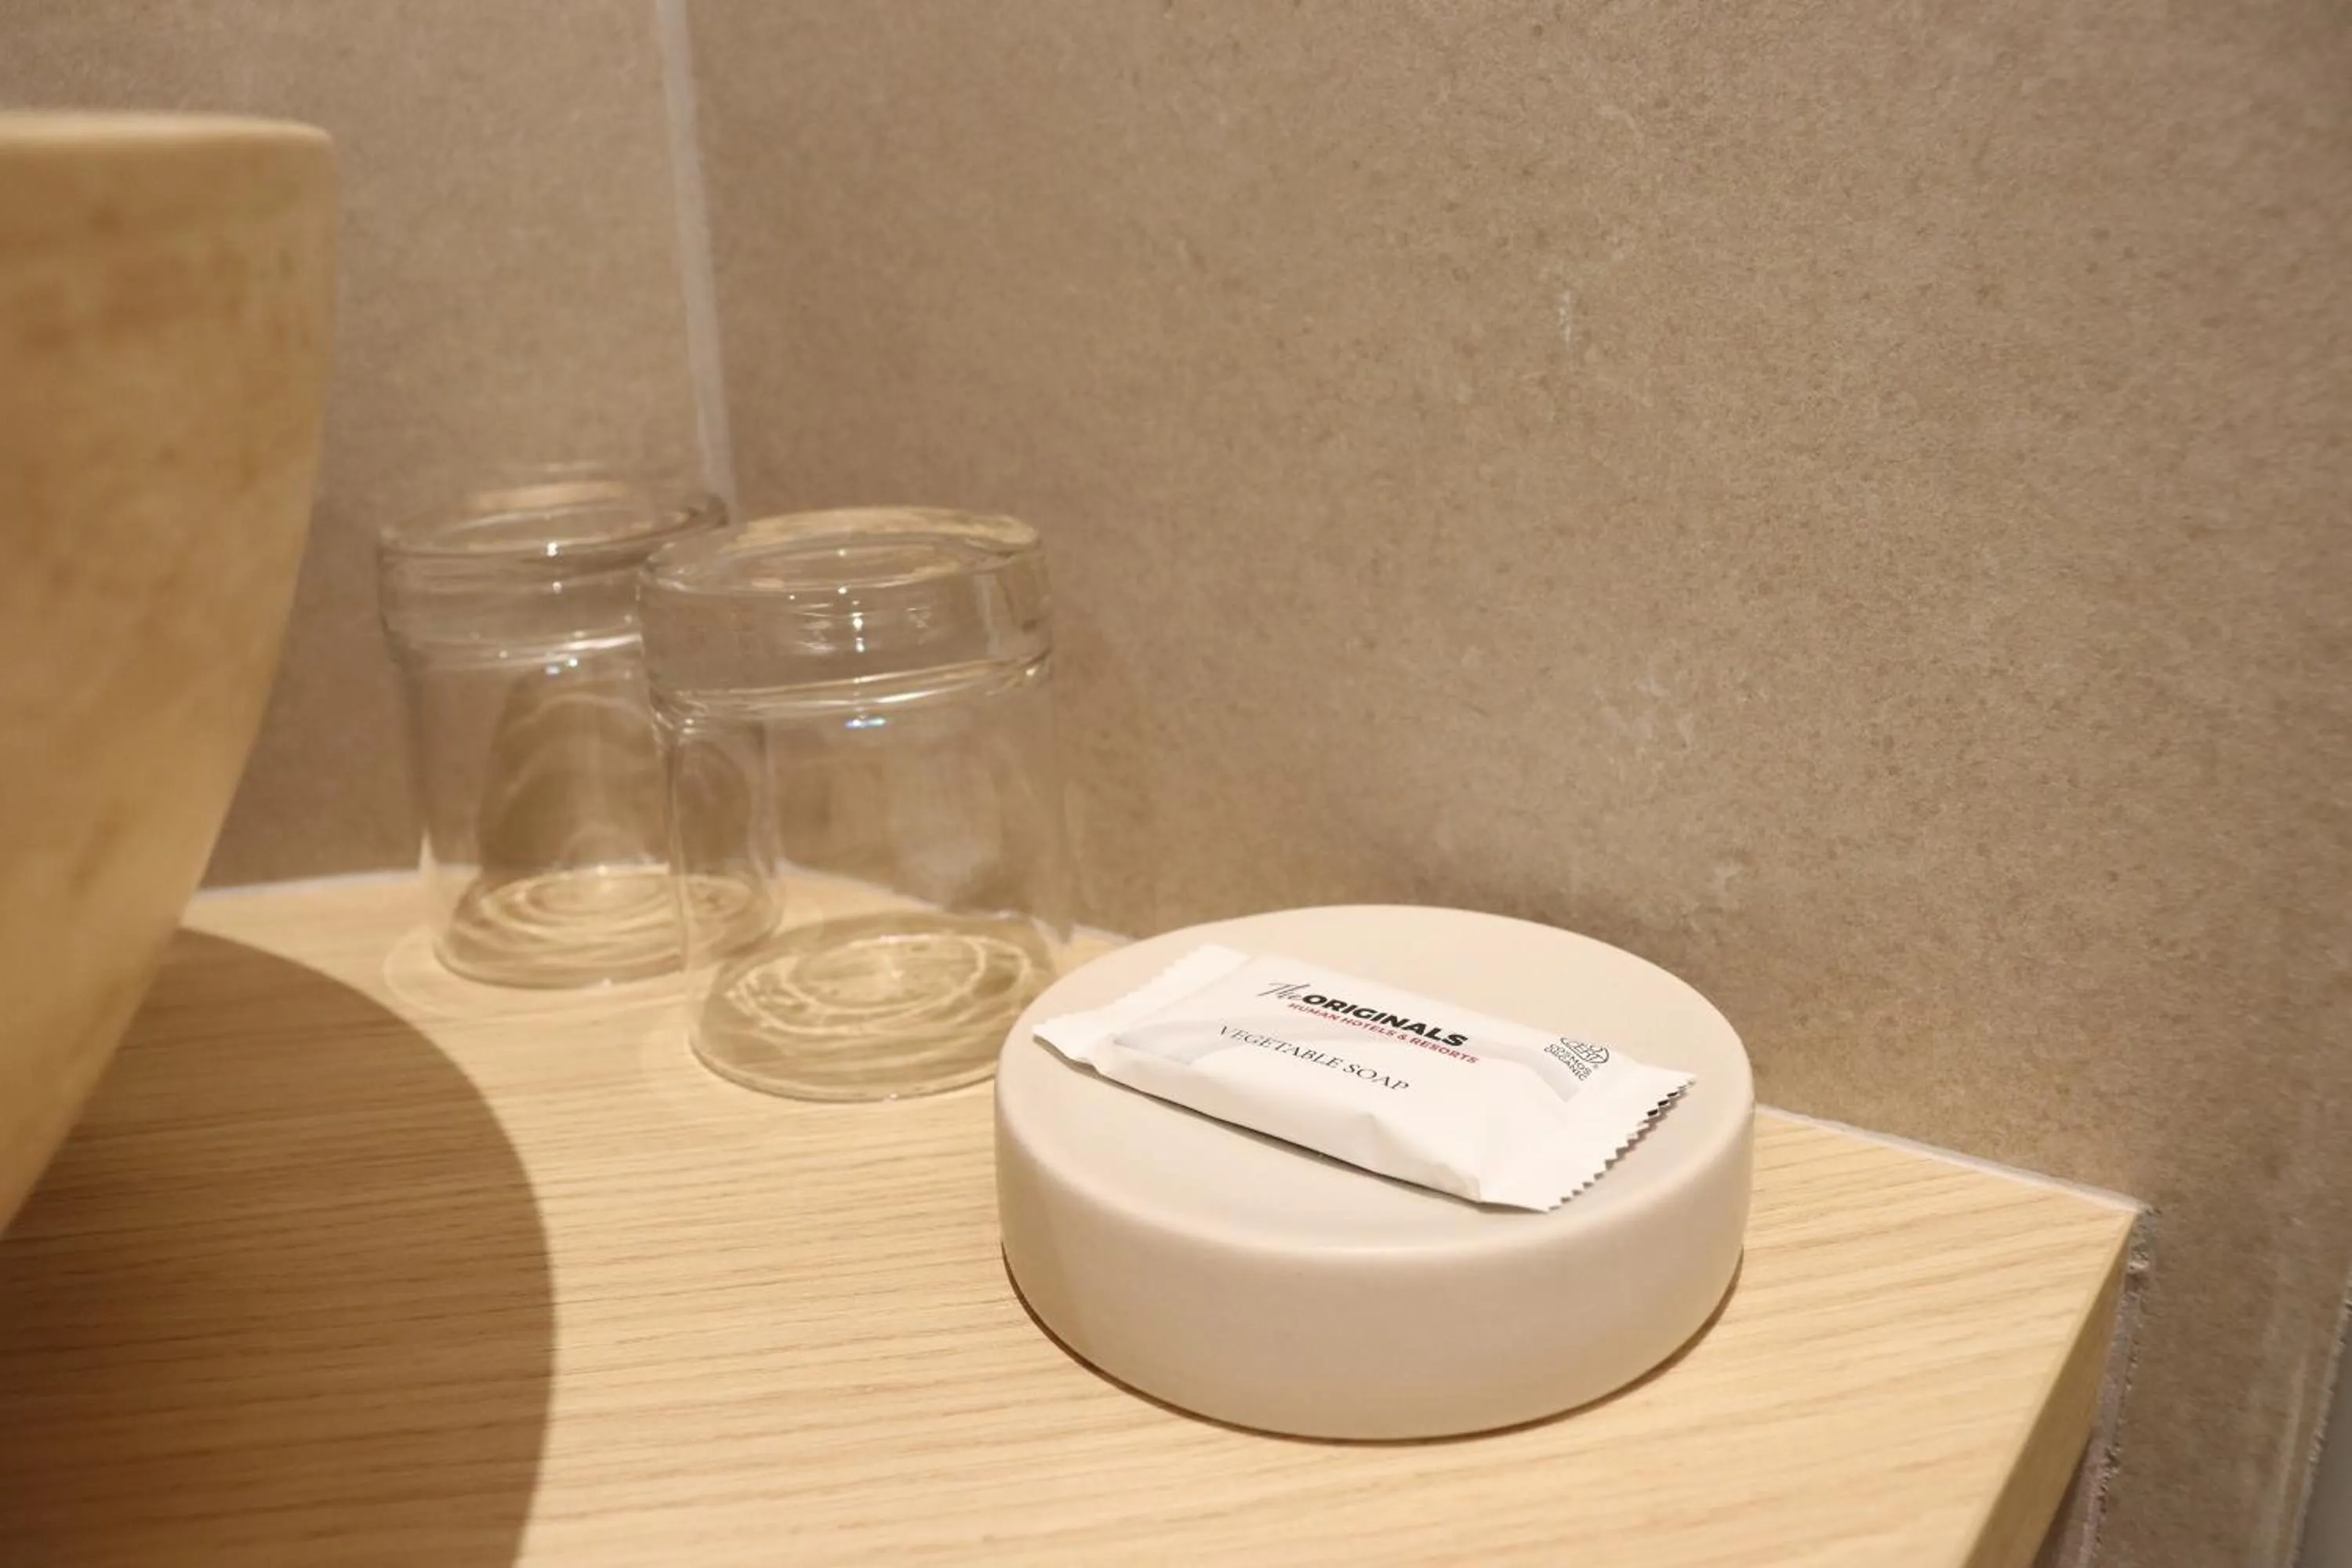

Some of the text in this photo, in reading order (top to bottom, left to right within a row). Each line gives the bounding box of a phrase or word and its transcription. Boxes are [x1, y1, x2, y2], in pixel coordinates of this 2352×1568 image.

[1257, 982, 1468, 1047] The ORIGINALS
[1288, 1003, 1341, 1020] HUMAN
[1341, 1018, 1395, 1036] HOTELS
[1409, 1037, 1479, 1063] RESORTS
[1219, 1025, 1409, 1091] VEGETABLE SOAP
